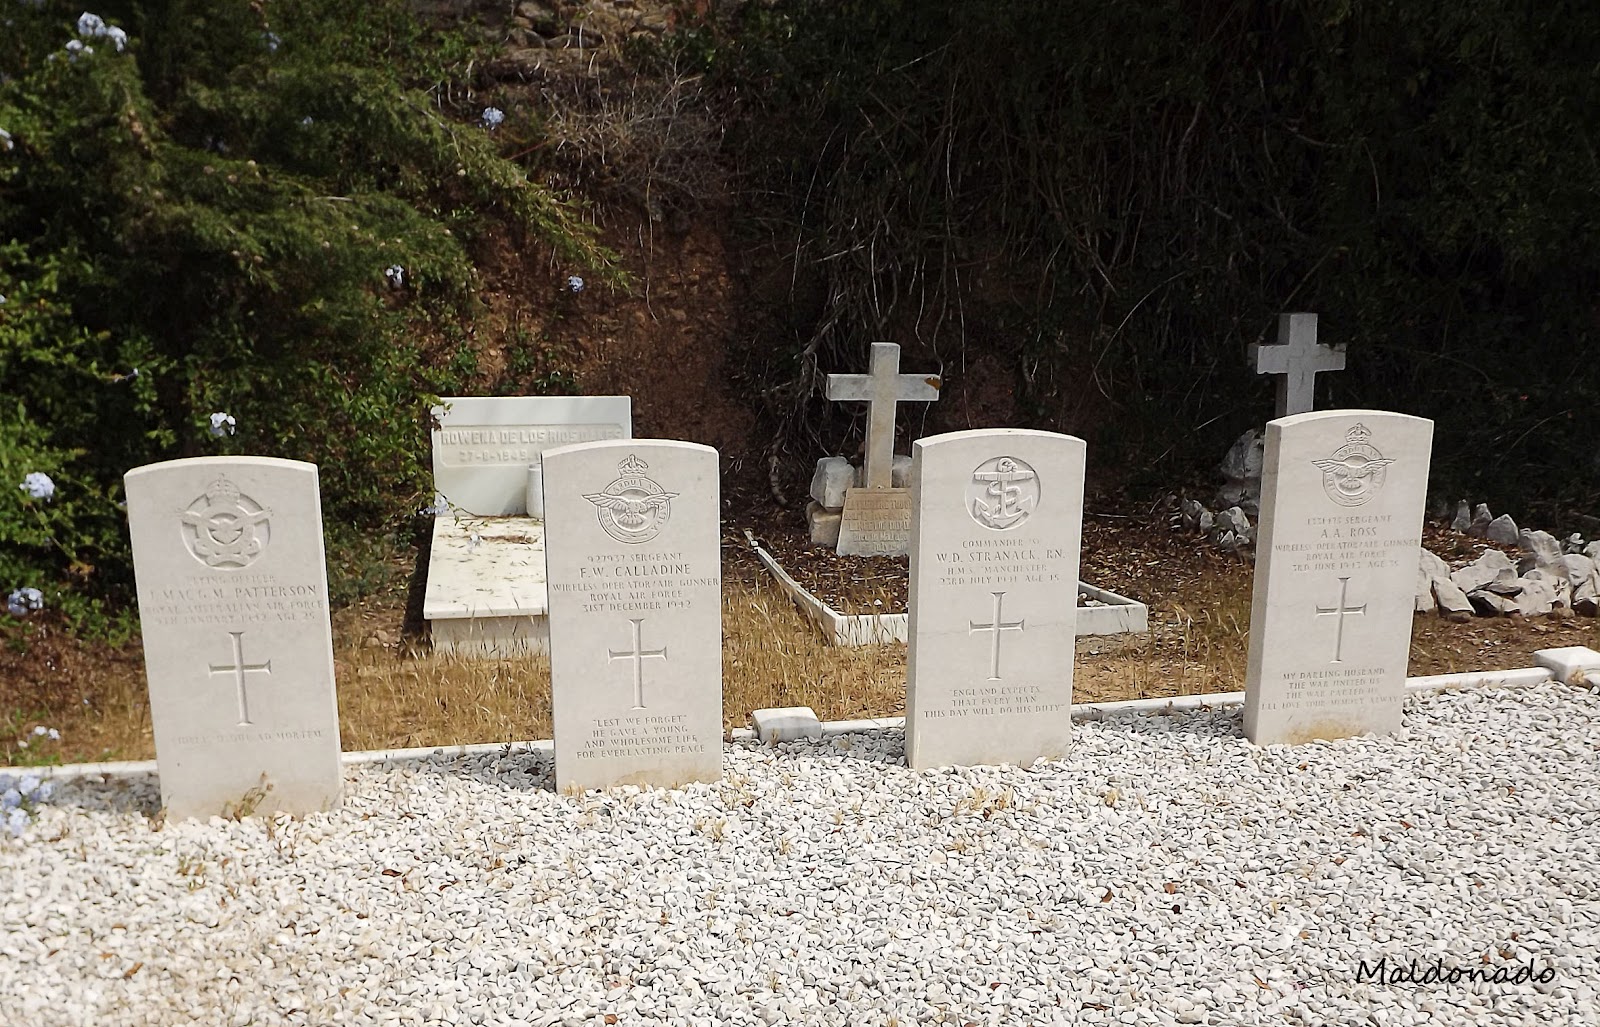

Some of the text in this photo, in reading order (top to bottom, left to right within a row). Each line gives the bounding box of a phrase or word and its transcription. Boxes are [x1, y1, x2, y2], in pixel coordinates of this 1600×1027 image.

[440, 429, 498, 446] ROWENA
[501, 429, 518, 445] DE
[521, 429, 546, 445] LOS
[1344, 514, 1392, 524] SERGEANT
[1350, 527, 1377, 537] ROSS
[962, 538, 1023, 549] COMMANDER
[1275, 543, 1312, 552] WIRELESS
[1383, 538, 1420, 548] GUNNER
[630, 552, 683, 562] SERGEANT
[936, 552, 964, 563] W.D.
[1306, 550, 1386, 561] ROYAL AIR FORCE
[579, 563, 691, 578] F.W. CALLADINE
[1314, 562, 1336, 571] JUNE
[1368, 560, 1385, 569] AGE
[231, 574, 277, 583] OFFICER
[552, 582, 597, 592] WIRELESS
[679, 577, 719, 587] GUNNER
[970, 575, 992, 585] JULY
[1025, 574, 1043, 583] AGE
[235, 585, 316, 599] PATTERSON
[590, 590, 683, 602] ROYAL AIR FORCE
[266, 601, 284, 610] AIR
[290, 599, 323, 609] FORCE
[582, 600, 692, 612] 31ST DECEMBER 1942
[1282, 667, 1385, 681] MY DARLING HUSBAND
[1289, 682, 1306, 690] THE
[1309, 680, 1328, 688] WAR
[1333, 678, 1366, 687] UNITED
[1286, 691, 1302, 700] THE
[1307, 690, 1325, 699] WAR
[1330, 689, 1364, 698] PARTED
[951, 695, 1037, 707] THAT EVERY MAN
[924, 709, 946, 719] THIS
[949, 708, 969, 718] DAY
[973, 707, 994, 716] WILL
[1000, 706, 1012, 715] DO
[1016, 705, 1032, 714] HIS
[593, 718, 620, 727] "LEST
[626, 717, 640, 726] WE
[276, 729, 322, 740] MORTEM
[592, 729, 605, 738] HE
[610, 727, 637, 737] GAVE
[653, 724, 688, 735] YOUNG
[584, 734, 698, 749] AND WHOLESOME LIFE
[576, 743, 705, 759] FOR EVERLASTING PEACE
